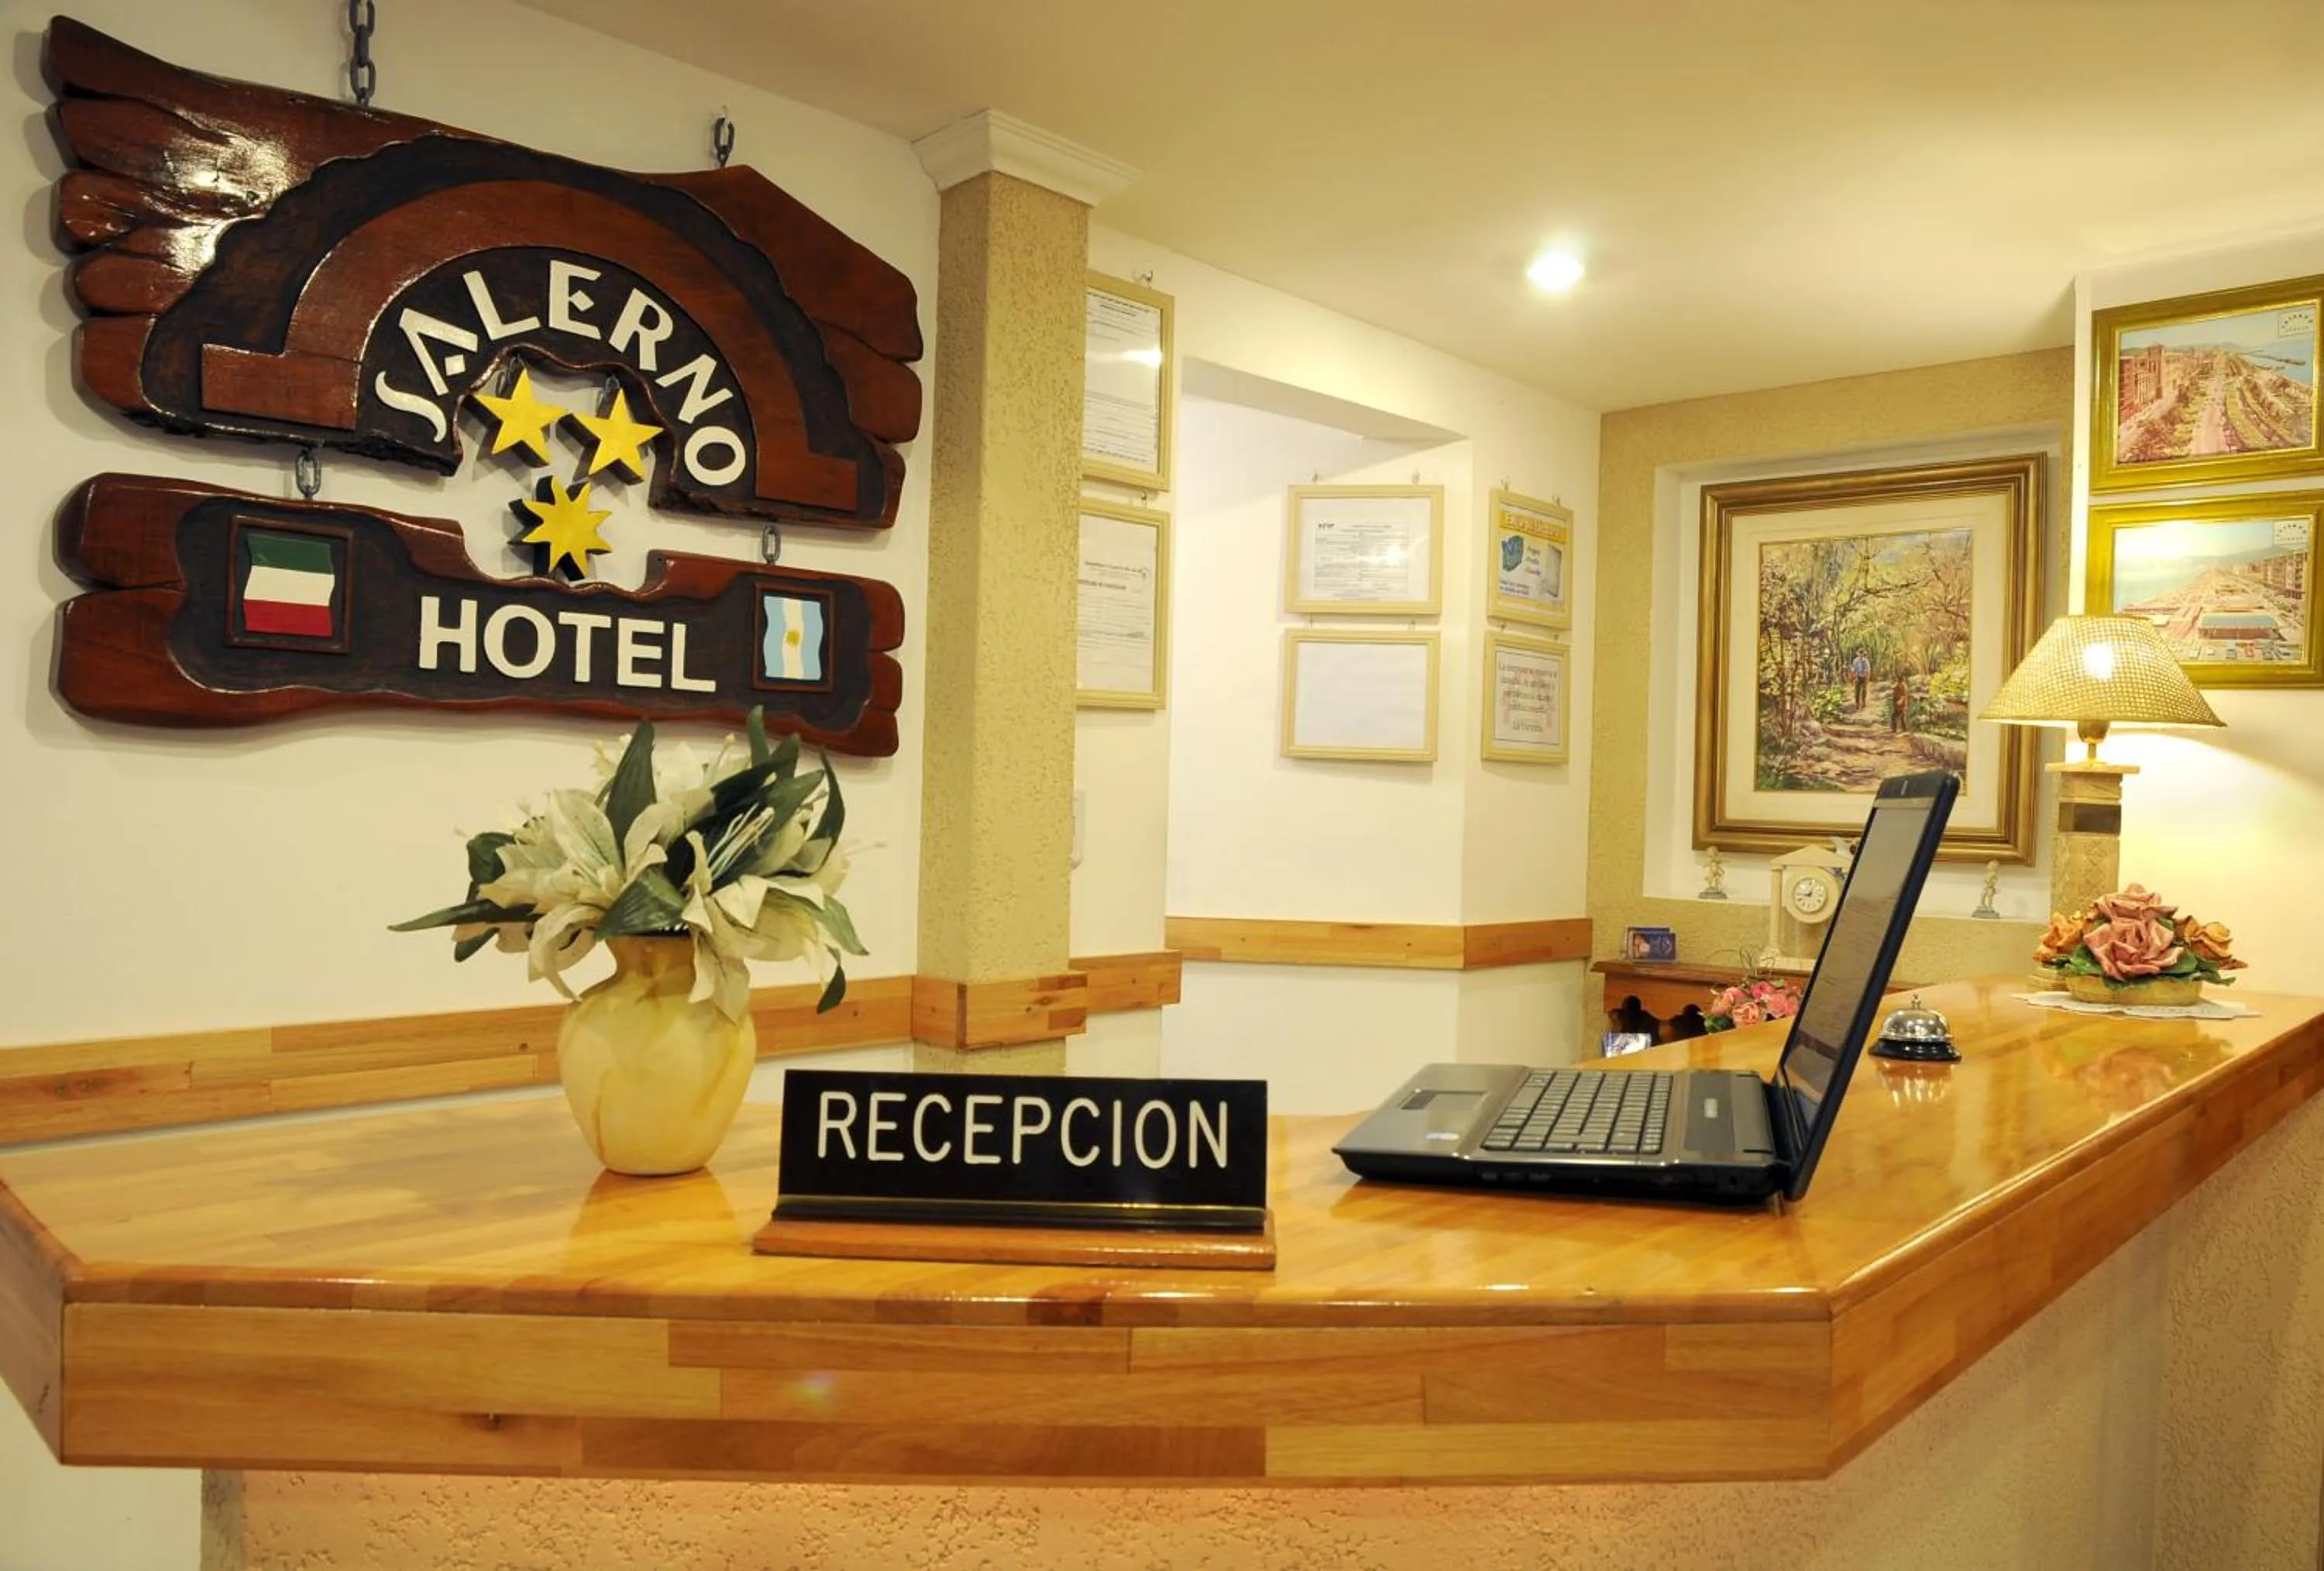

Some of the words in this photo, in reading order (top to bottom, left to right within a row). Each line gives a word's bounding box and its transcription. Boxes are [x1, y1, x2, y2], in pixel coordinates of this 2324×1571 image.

[375, 260, 746, 486] SALERNO
[418, 596, 717, 693] HOTEL
[817, 1091, 1228, 1168] RECEPCION
